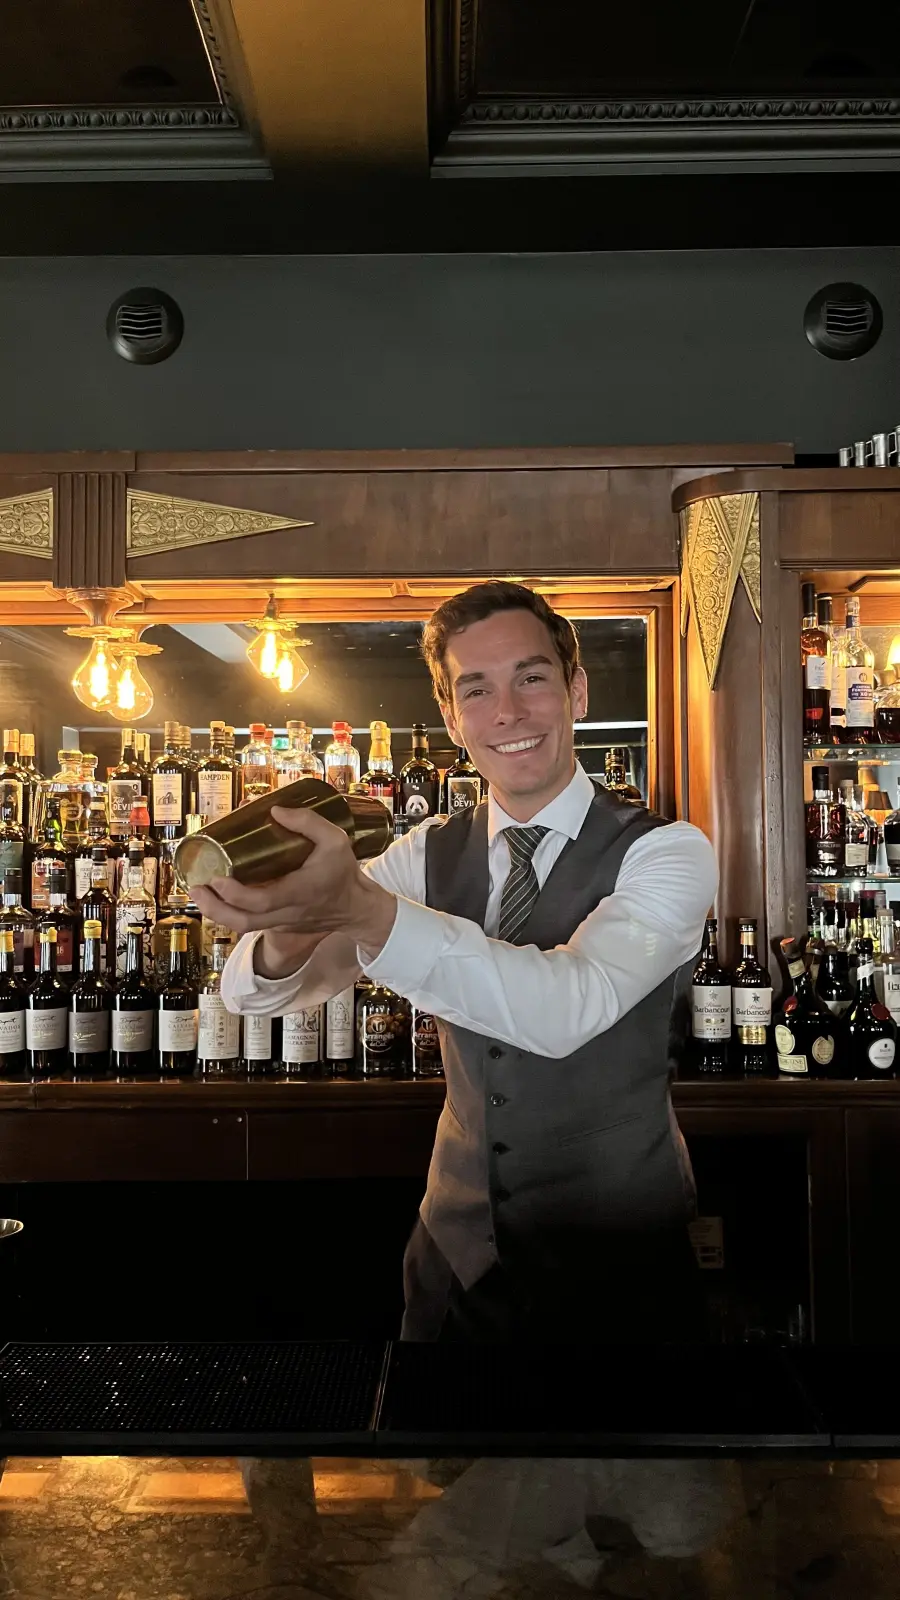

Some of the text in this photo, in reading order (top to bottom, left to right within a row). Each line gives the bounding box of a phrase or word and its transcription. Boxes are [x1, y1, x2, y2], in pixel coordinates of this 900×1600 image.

[113, 803, 133, 811] DEVI
[694, 1005, 730, 1013] Barbancour
[735, 1007, 771, 1016] Barbancour
